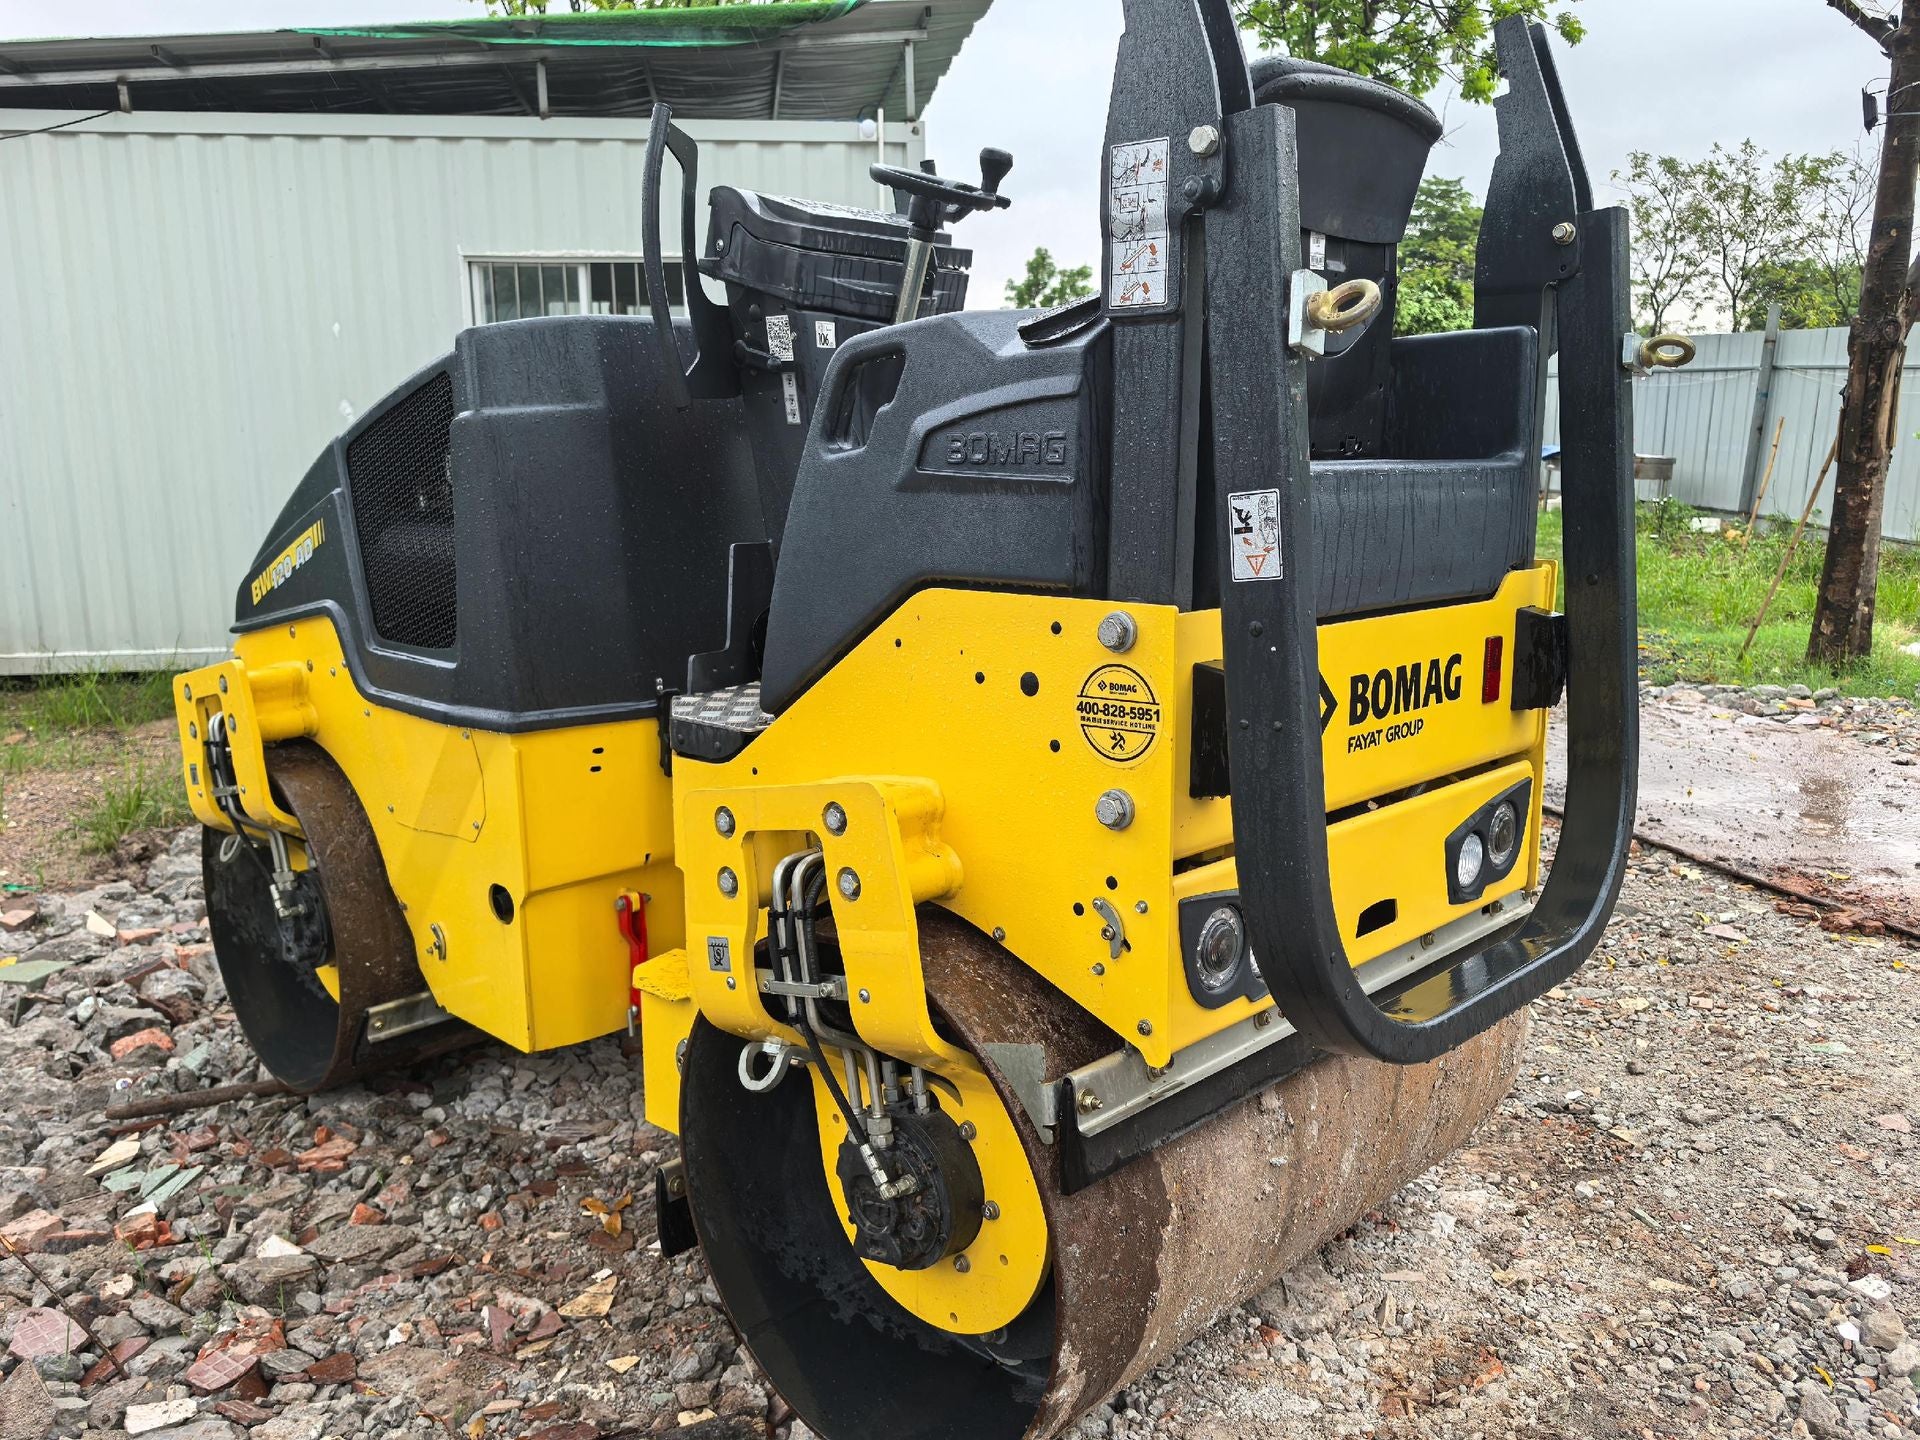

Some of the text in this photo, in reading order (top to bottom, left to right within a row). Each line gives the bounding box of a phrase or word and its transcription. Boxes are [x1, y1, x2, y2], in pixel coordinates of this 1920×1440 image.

[945, 431, 1067, 465] BOMAG
[296, 536, 314, 570] AD
[1109, 683, 1137, 693] BOMAG
[1349, 653, 1462, 726] BOMAG
[1076, 701, 1160, 722] 400-828-5951
[1103, 719, 1128, 727] SERVICE
[1347, 718, 1424, 754] FAYAT GROUP
